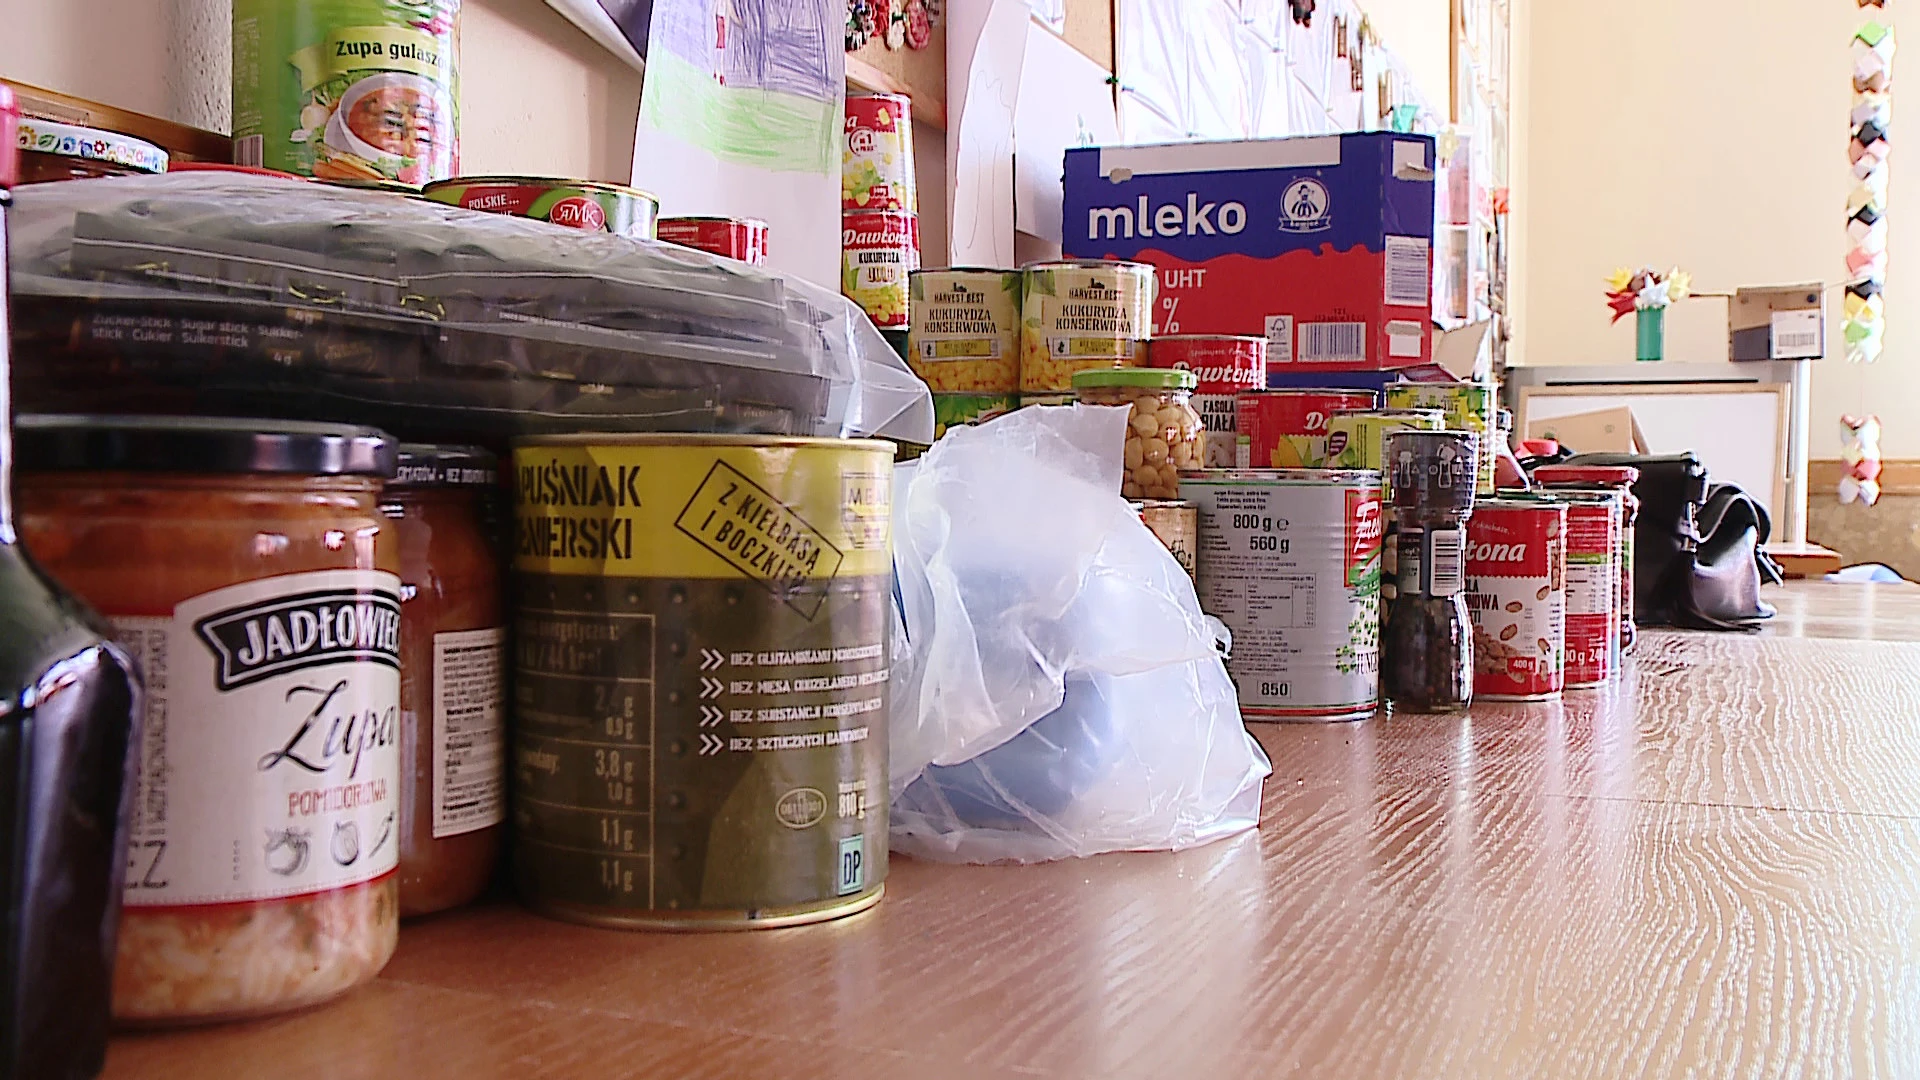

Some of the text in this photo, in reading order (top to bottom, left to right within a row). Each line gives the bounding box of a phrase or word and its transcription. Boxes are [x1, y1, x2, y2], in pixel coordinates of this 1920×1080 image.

[335, 41, 383, 59] Zupa
[468, 194, 507, 210] POLSKIE
[1088, 192, 1247, 240] mleko
[1165, 269, 1207, 288] UHT
[934, 292, 985, 304] HARVEST BEST
[1069, 288, 1124, 300] HARVEST BEST
[929, 308, 991, 321] KUKURYDZA
[1062, 304, 1127, 319] KUKURYDZA
[924, 321, 997, 334] KONSERWOWA
[1055, 318, 1131, 333] KONSERWOWA
[1173, 361, 1261, 383] awton
[1203, 400, 1235, 413] FASOLA
[700, 510, 716, 531] I
[718, 482, 821, 575] Z KIEŁBASĄ
[1233, 514, 1260, 529] 800
[1262, 517, 1272, 532] g
[1250, 535, 1290, 554] 560 g
[1465, 540, 1527, 562] tona
[730, 652, 754, 666] BEZ
[1513, 659, 1534, 671] 400 g
[1577, 653, 1586, 666] g
[1588, 649, 1605, 663] 24
[730, 681, 753, 694] BEZ
[1260, 682, 1289, 697] 850
[730, 709, 753, 722] BEZ
[257, 680, 398, 779] Zupa
[730, 738, 753, 751] BEZ
[595, 749, 620, 780] 3,8
[288, 784, 388, 817] POMIDOROWA
[838, 793, 857, 819] 810
[857, 795, 865, 820] g
[600, 817, 620, 847] 1,1
[843, 850, 861, 885] DP
